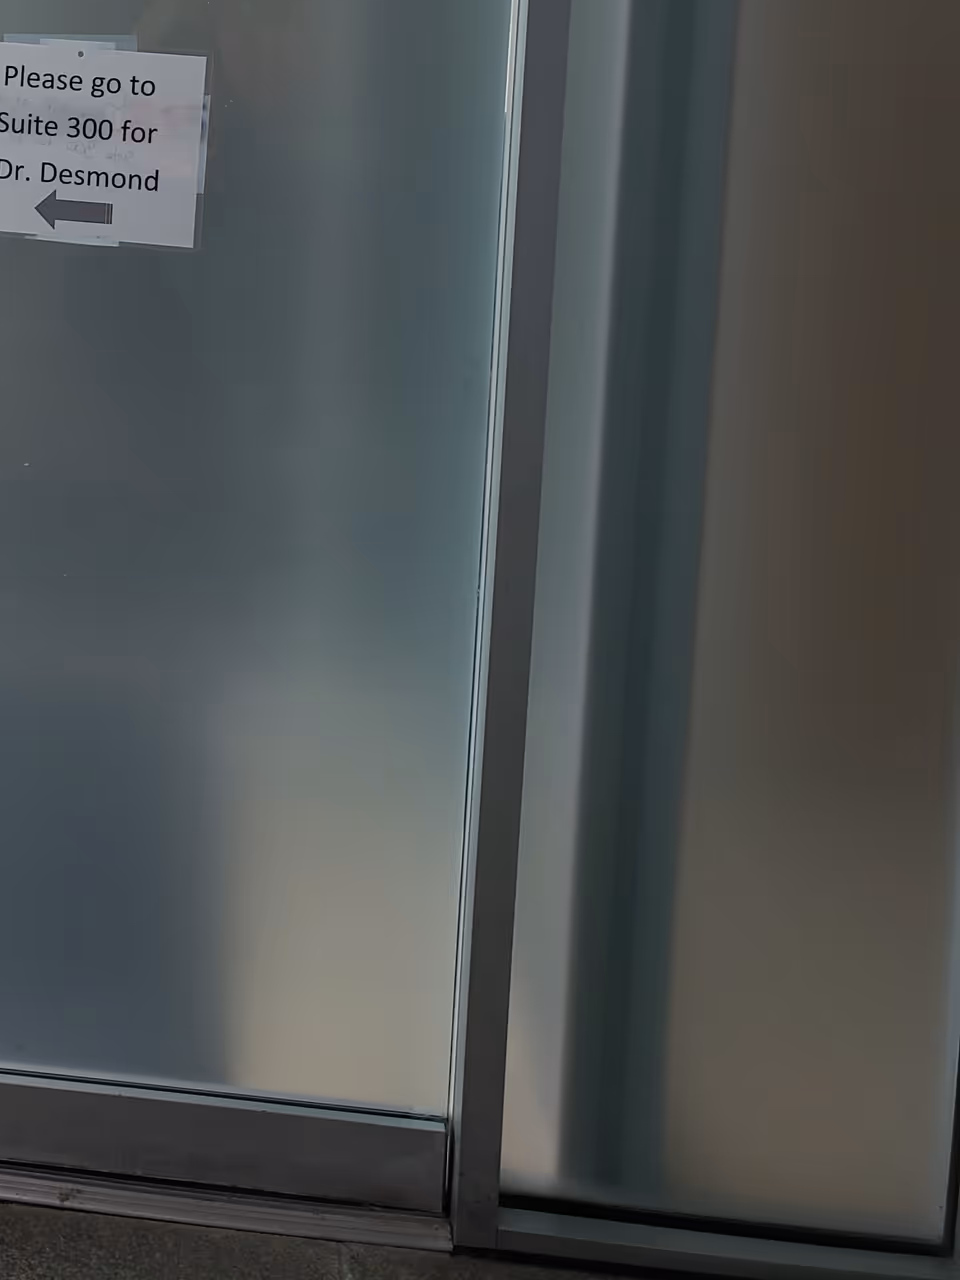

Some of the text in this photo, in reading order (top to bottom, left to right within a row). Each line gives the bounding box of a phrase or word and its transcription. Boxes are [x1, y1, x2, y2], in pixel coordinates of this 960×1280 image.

[4, 64, 156, 98] Please go to
[66, 116, 114, 141] 300
[121, 119, 159, 144] for
[40, 161, 160, 192] Desmond
